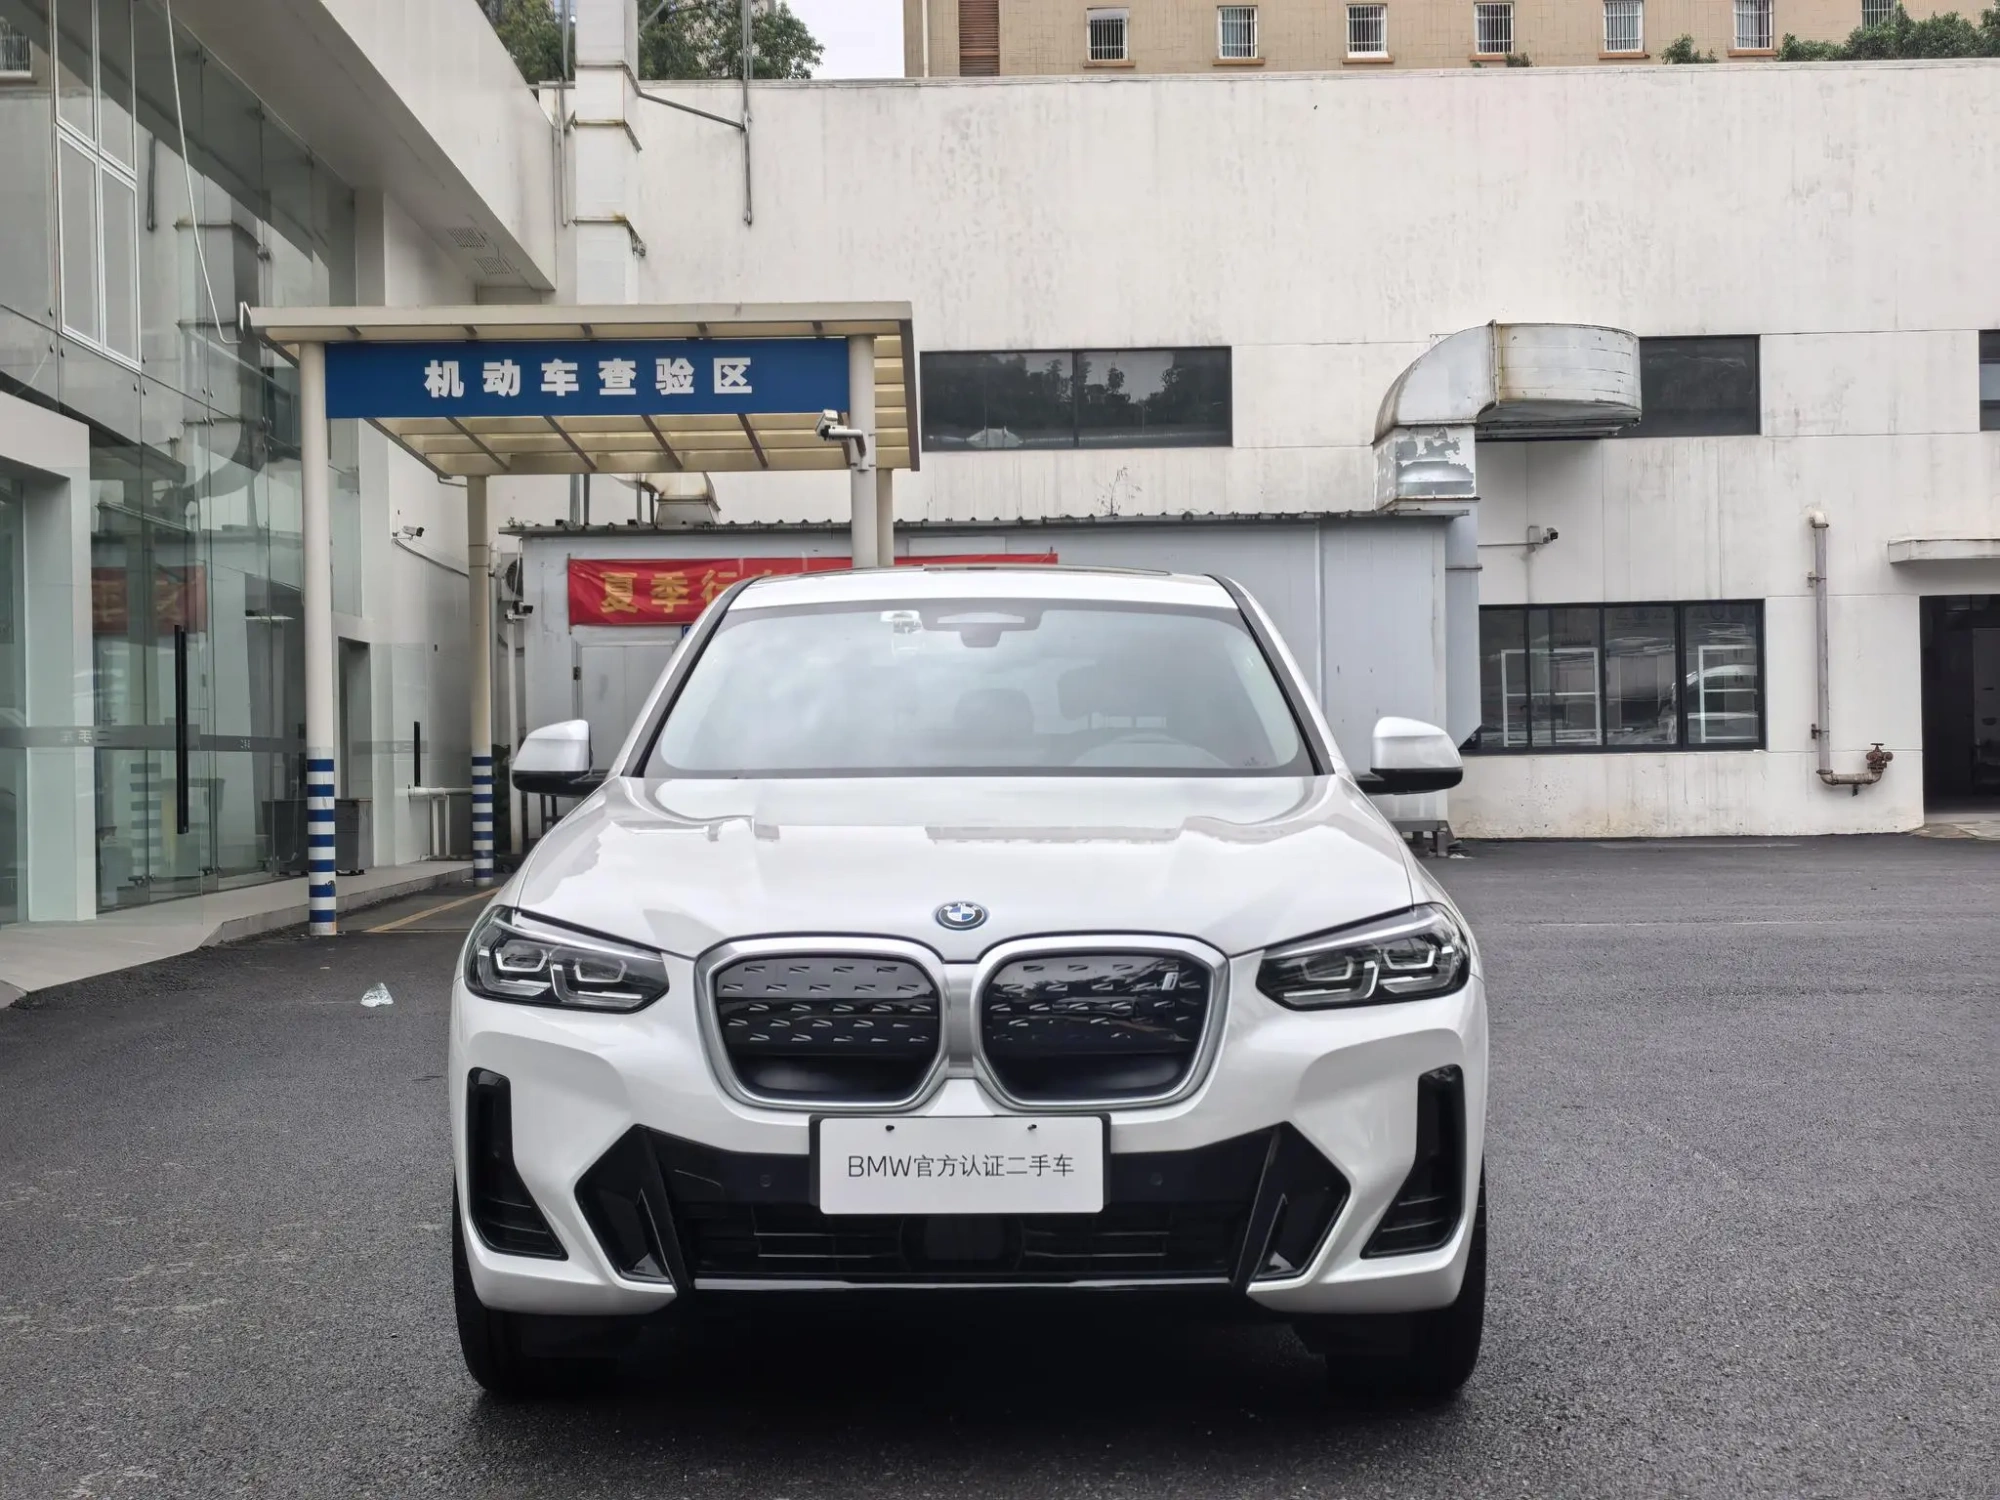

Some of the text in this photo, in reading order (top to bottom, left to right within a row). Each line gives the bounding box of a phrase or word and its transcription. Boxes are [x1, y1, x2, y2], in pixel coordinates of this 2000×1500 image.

[424, 357, 753, 397] 机动车查验区
[600, 569, 773, 614] 夏季行
[848, 1153, 1075, 1178] BMW官方认证二手车
